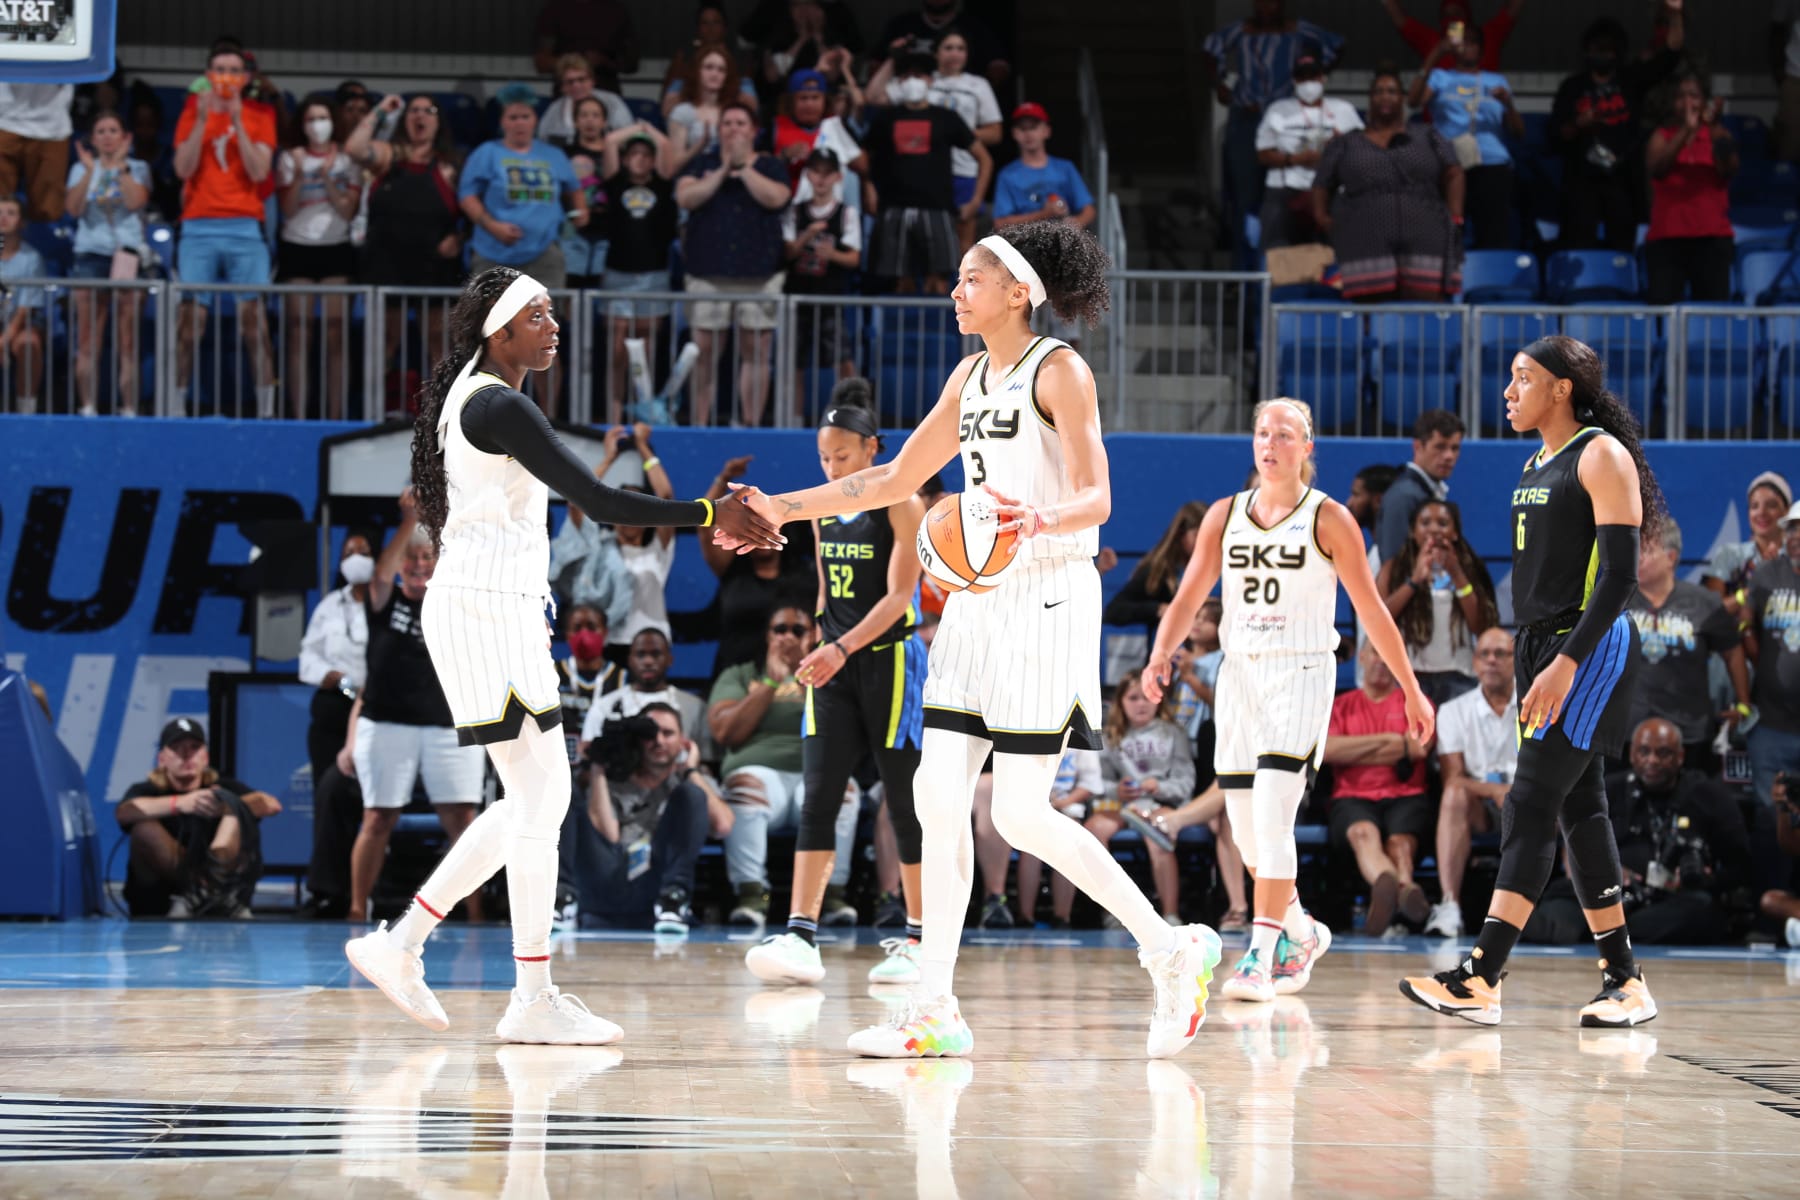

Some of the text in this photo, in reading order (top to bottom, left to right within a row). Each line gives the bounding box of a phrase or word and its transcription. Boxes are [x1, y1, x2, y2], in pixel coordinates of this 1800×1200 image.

[0, 0, 55, 22] AT&T
[959, 408, 1020, 443] SKY
[970, 451, 987, 486] 3
[1512, 487, 1551, 506] EXAS
[1516, 512, 1526, 551] 6
[819, 541, 875, 560] TEXAS
[1228, 544, 1307, 570] SKY
[828, 563, 856, 599] 52
[1243, 576, 1281, 606] 20
